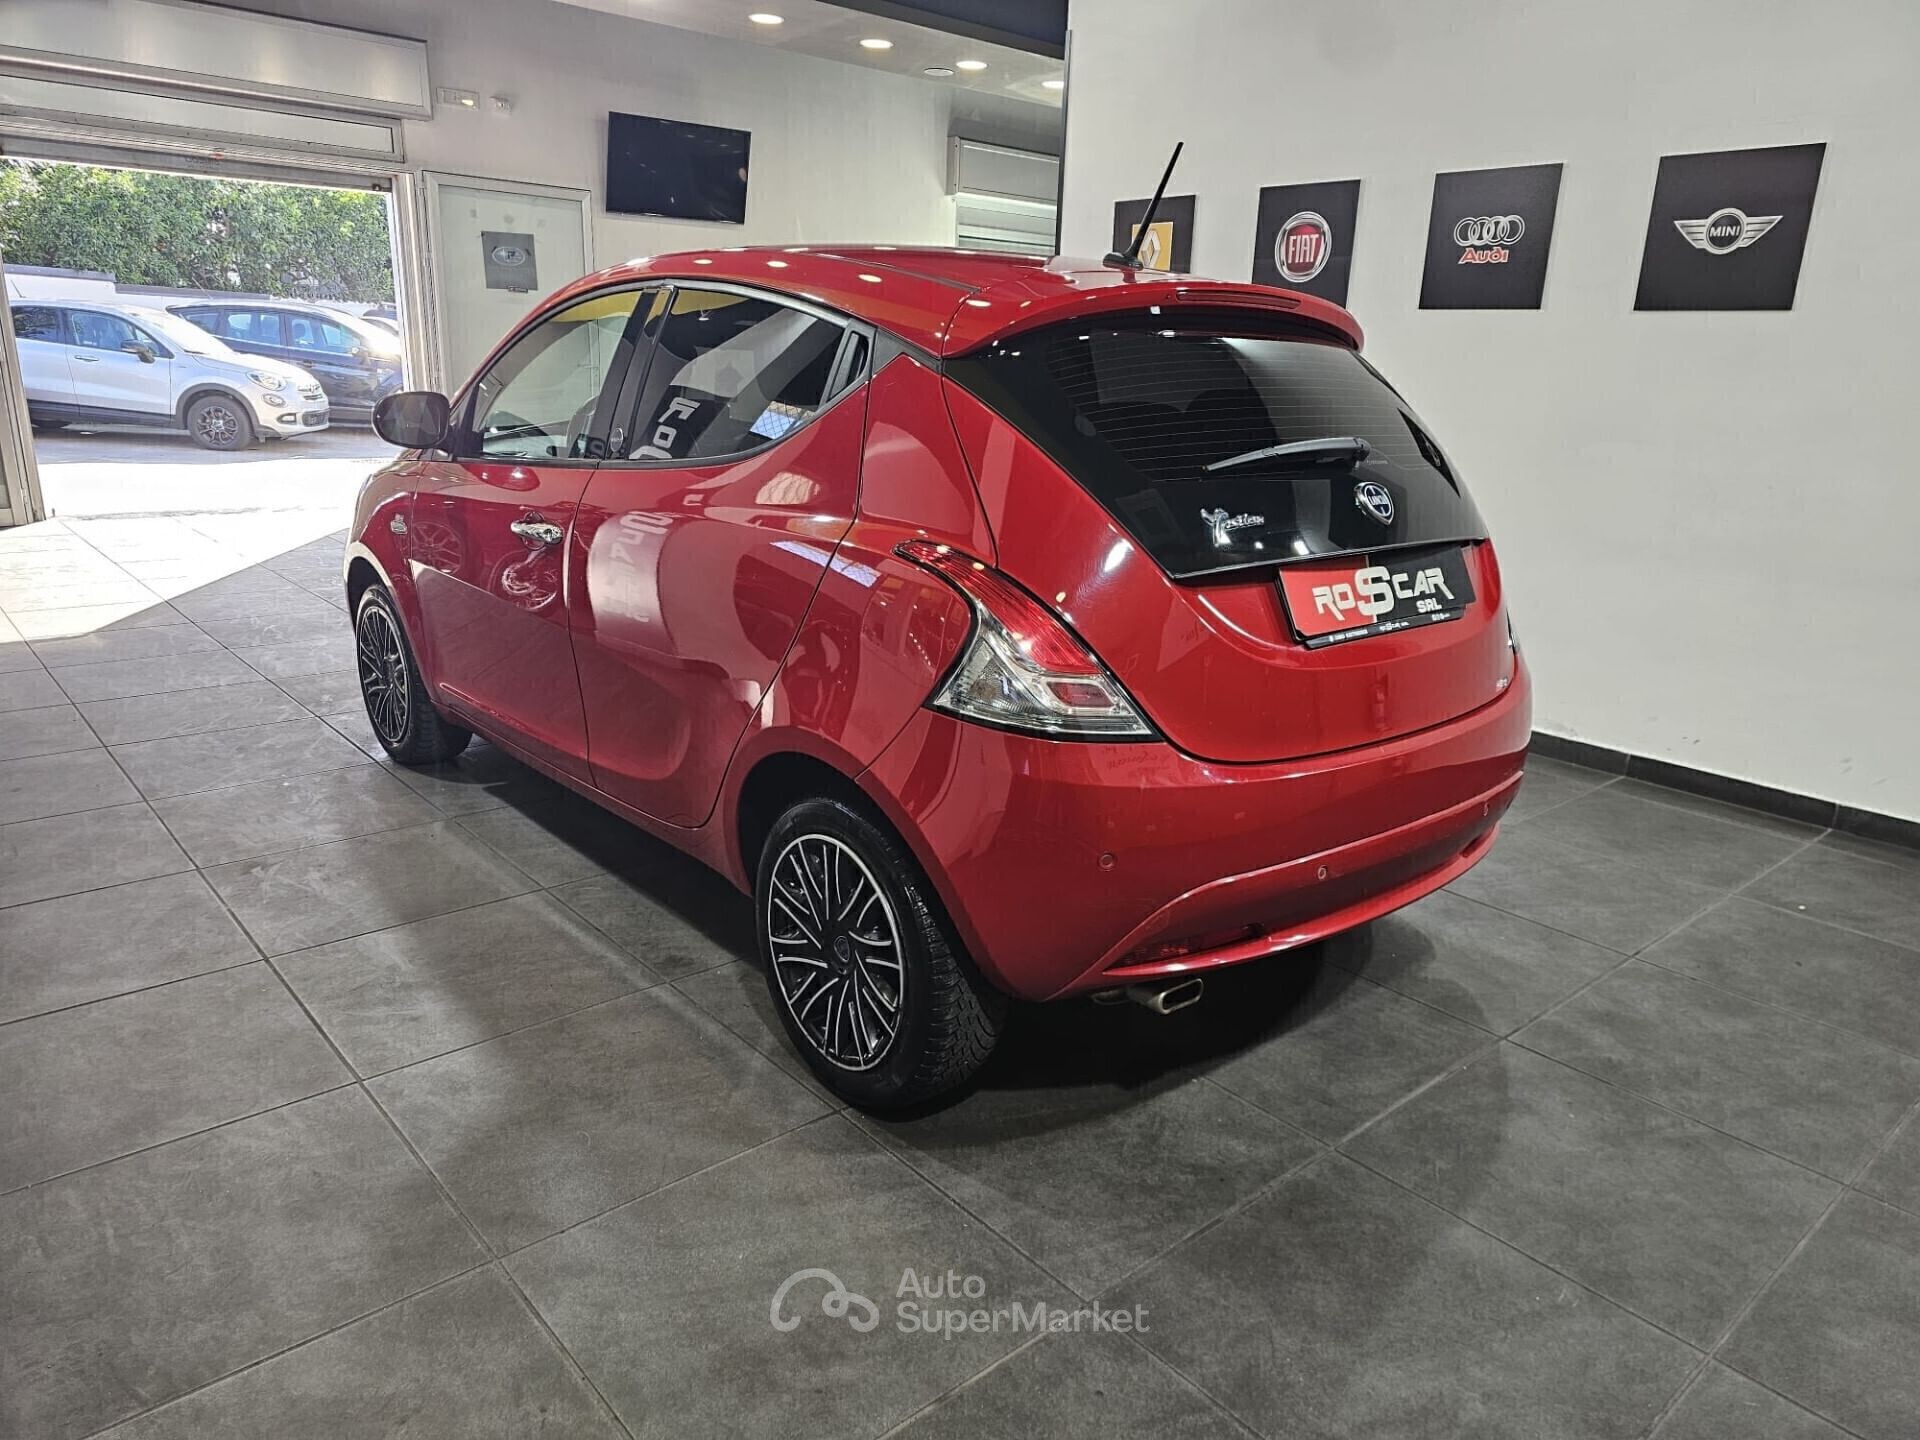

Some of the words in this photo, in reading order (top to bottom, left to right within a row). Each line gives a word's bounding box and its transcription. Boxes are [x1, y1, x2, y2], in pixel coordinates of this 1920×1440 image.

[1709, 225, 1741, 237] MINI
[1288, 233, 1320, 264] FIAT
[1458, 246, 1510, 265] Audi
[1415, 597, 1443, 614] SRL
